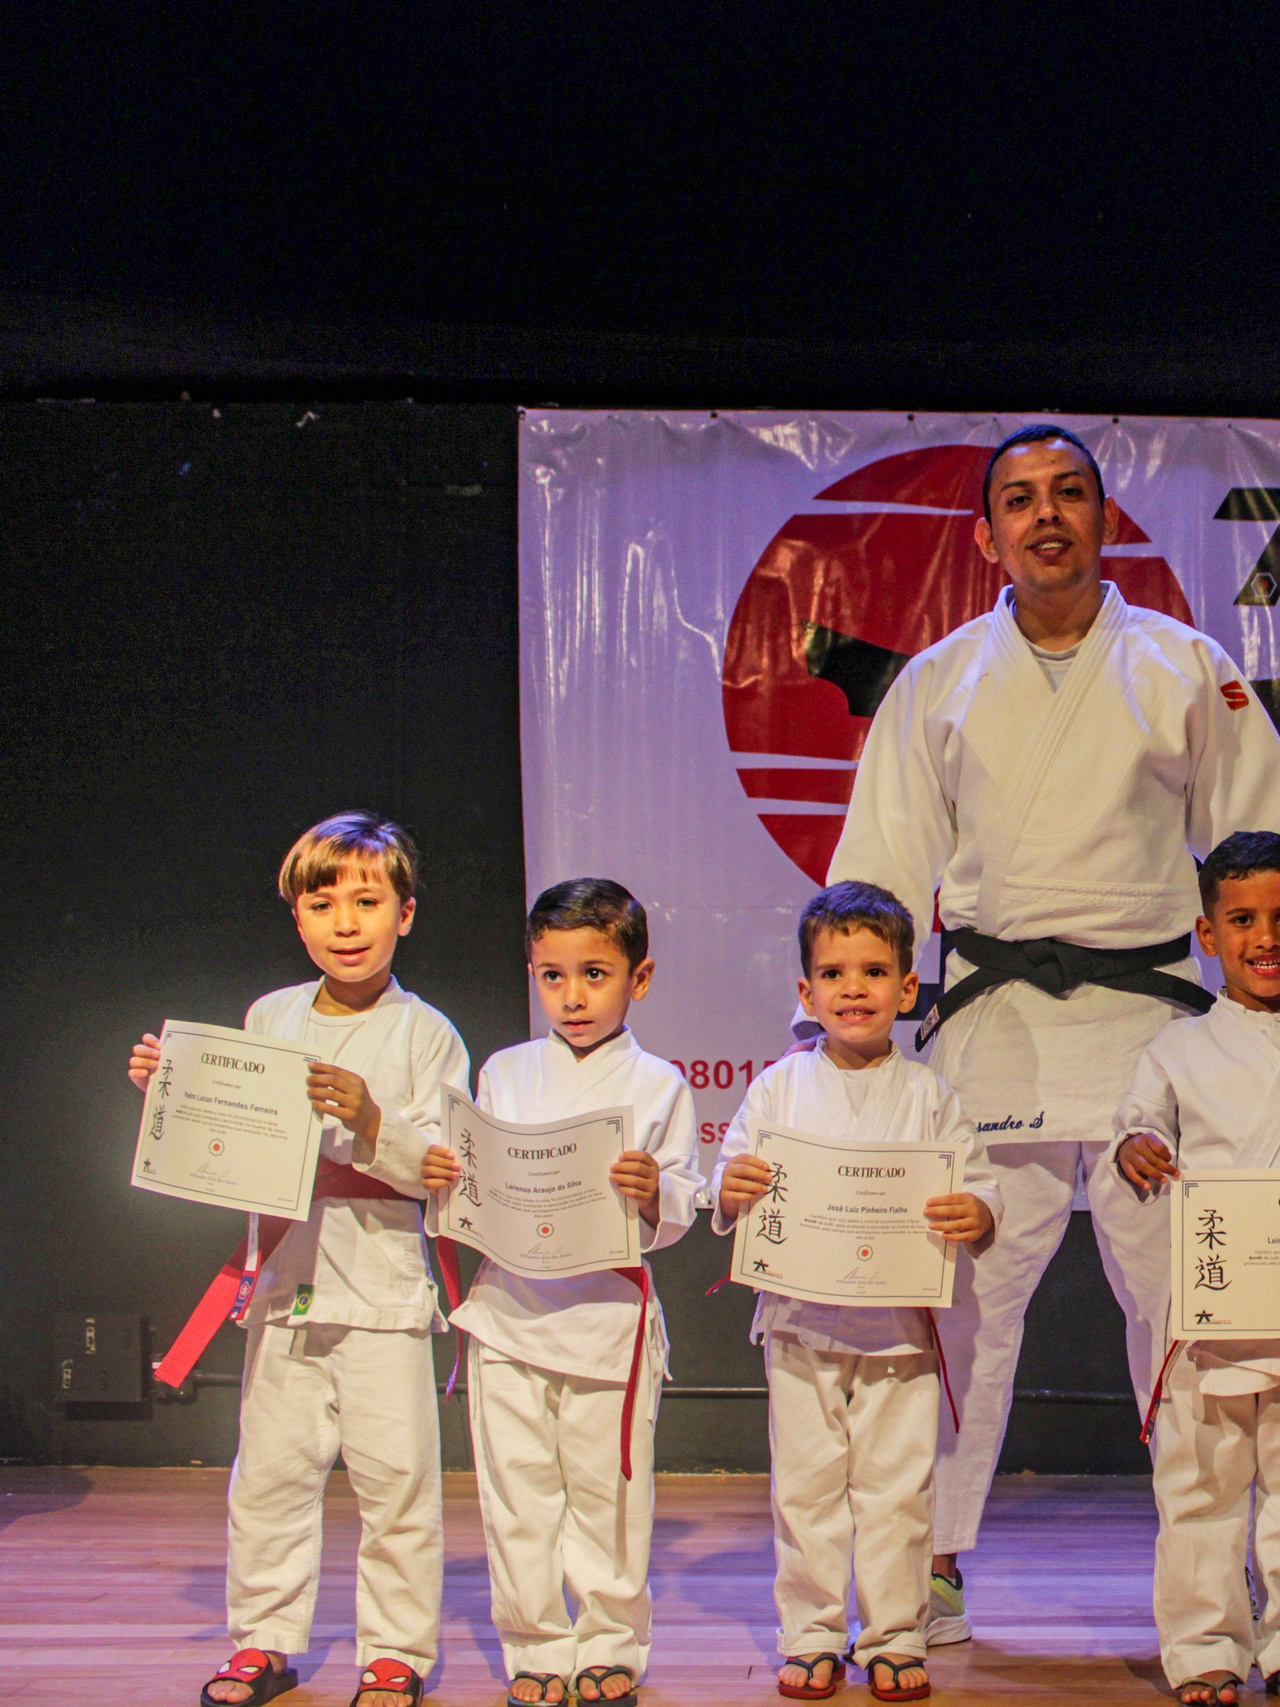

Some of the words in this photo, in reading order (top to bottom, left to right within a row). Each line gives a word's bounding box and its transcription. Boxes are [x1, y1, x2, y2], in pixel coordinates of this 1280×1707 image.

[201, 1052, 265, 1074] CERTIFICADO
[670, 1059, 777, 1090] 801
[197, 1094, 212, 1103] Lucas
[214, 1097, 248, 1110] Fernandes
[250, 1104, 278, 1115] Ferreira
[507, 1143, 577, 1160] CERTIFICADO
[838, 1165, 905, 1178] CERTIFICADO
[505, 1182, 531, 1193] Lorenzo
[533, 1187, 556, 1195] Araujo
[557, 1183, 565, 1191] da
[567, 1180, 582, 1189] Silva
[827, 1203, 843, 1212] José
[1194, 1208, 1233, 1291] 柔道
